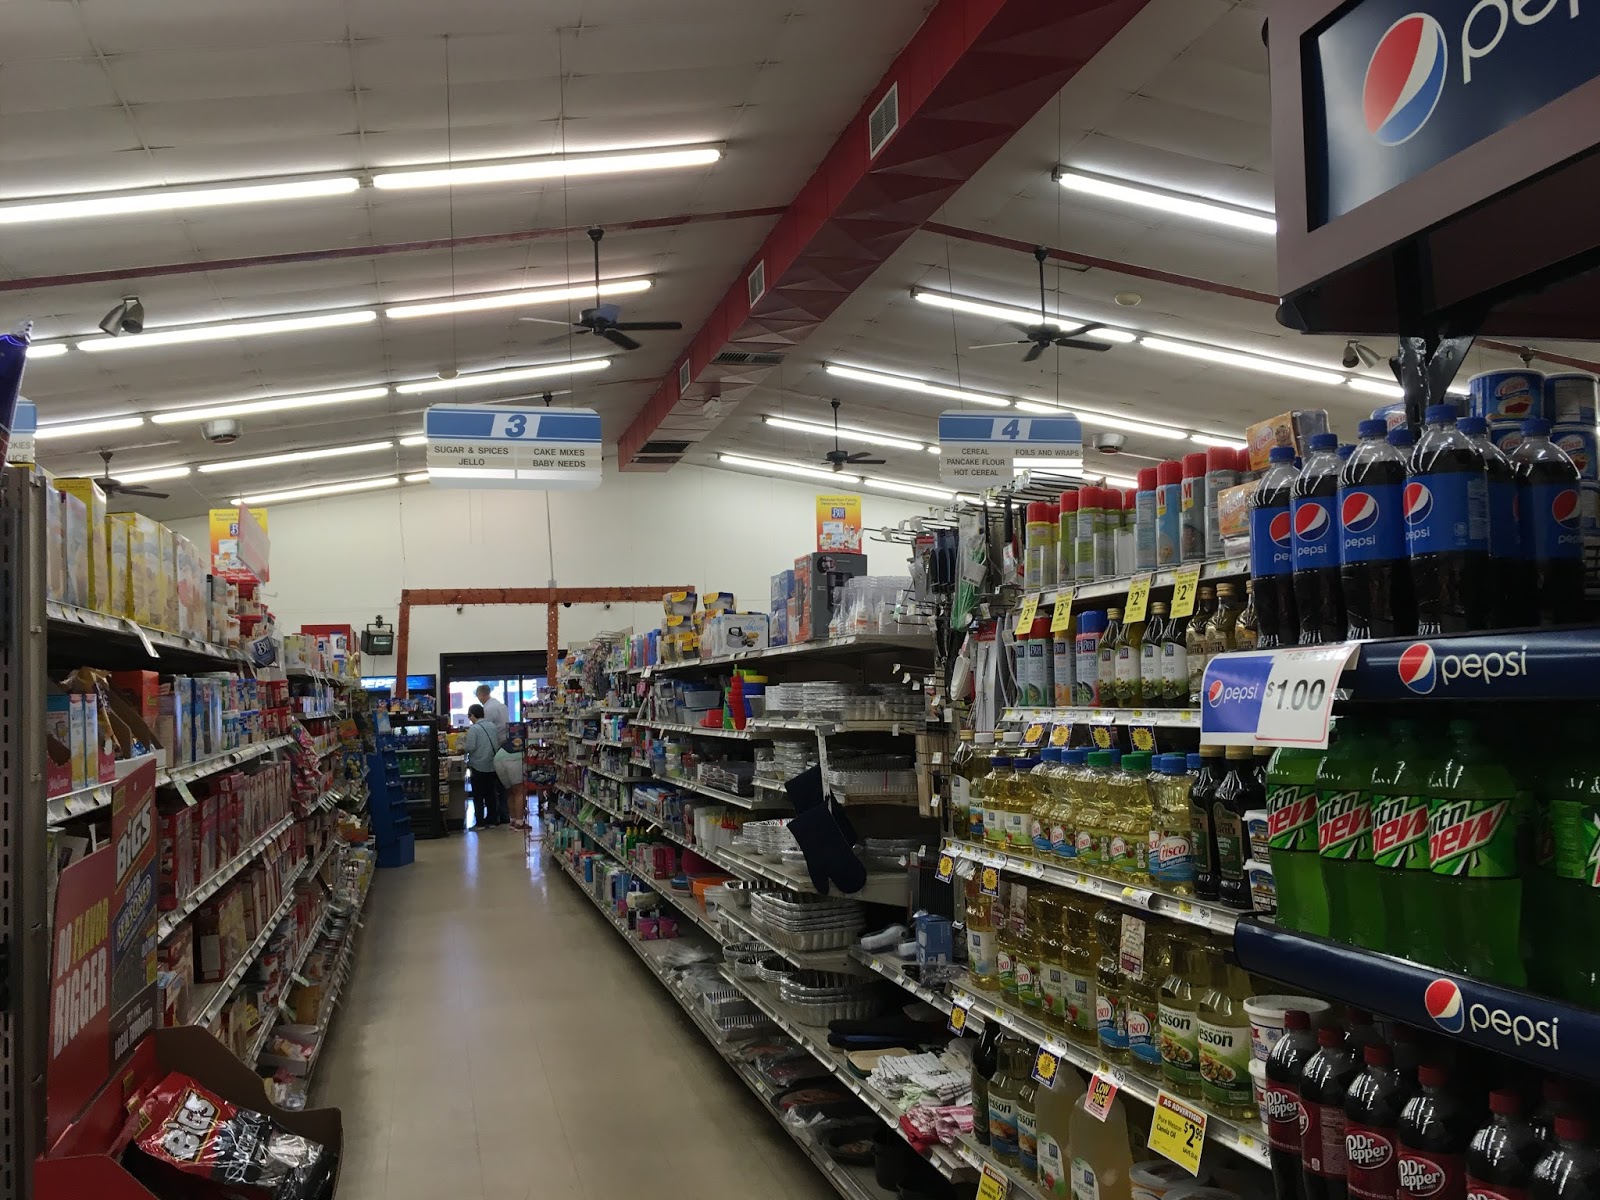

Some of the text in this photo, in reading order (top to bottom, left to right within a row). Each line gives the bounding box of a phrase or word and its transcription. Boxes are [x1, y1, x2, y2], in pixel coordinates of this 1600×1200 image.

[504, 414, 528, 438] 3
[1001, 419, 1020, 440] 4
[434, 445, 509, 455] SUGAR & SPICES
[533, 448, 586, 457] CAKE MIXES
[961, 448, 990, 456] CEREAL
[1015, 449, 1036, 457] FOILS
[458, 458, 485, 466] JELLO
[532, 459, 586, 468] BABY NEEDS
[946, 458, 1005, 466] PANCAKE FLOUR
[953, 469, 999, 477] HOT CEREAL
[1406, 526, 1430, 541] pepsi
[1297, 543, 1328, 557] pepsi
[1345, 535, 1376, 550] pepsi
[1441, 645, 1527, 685] pepsi
[1223, 678, 1326, 711] pepsi $1.00
[1159, 844, 1186, 862] Crisco
[53, 946, 107, 1061] BIGGER
[1160, 1013, 1191, 1030] esson
[1471, 1003, 1559, 1051] pepsi
[1199, 1028, 1233, 1048] esson
[1095, 1081, 1111, 1096] LOW
[1092, 1092, 1109, 1108] PRICE
[1267, 1091, 1289, 1104] Dr
[1162, 1098, 1202, 1124] AS ADVERTISED
[1267, 1101, 1300, 1119] Pepper
[1346, 1134, 1375, 1150] Dr
[1347, 1144, 1389, 1165] Pepper
[1398, 1159, 1426, 1176] Dr
[1399, 1170, 1441, 1192] Pepper
